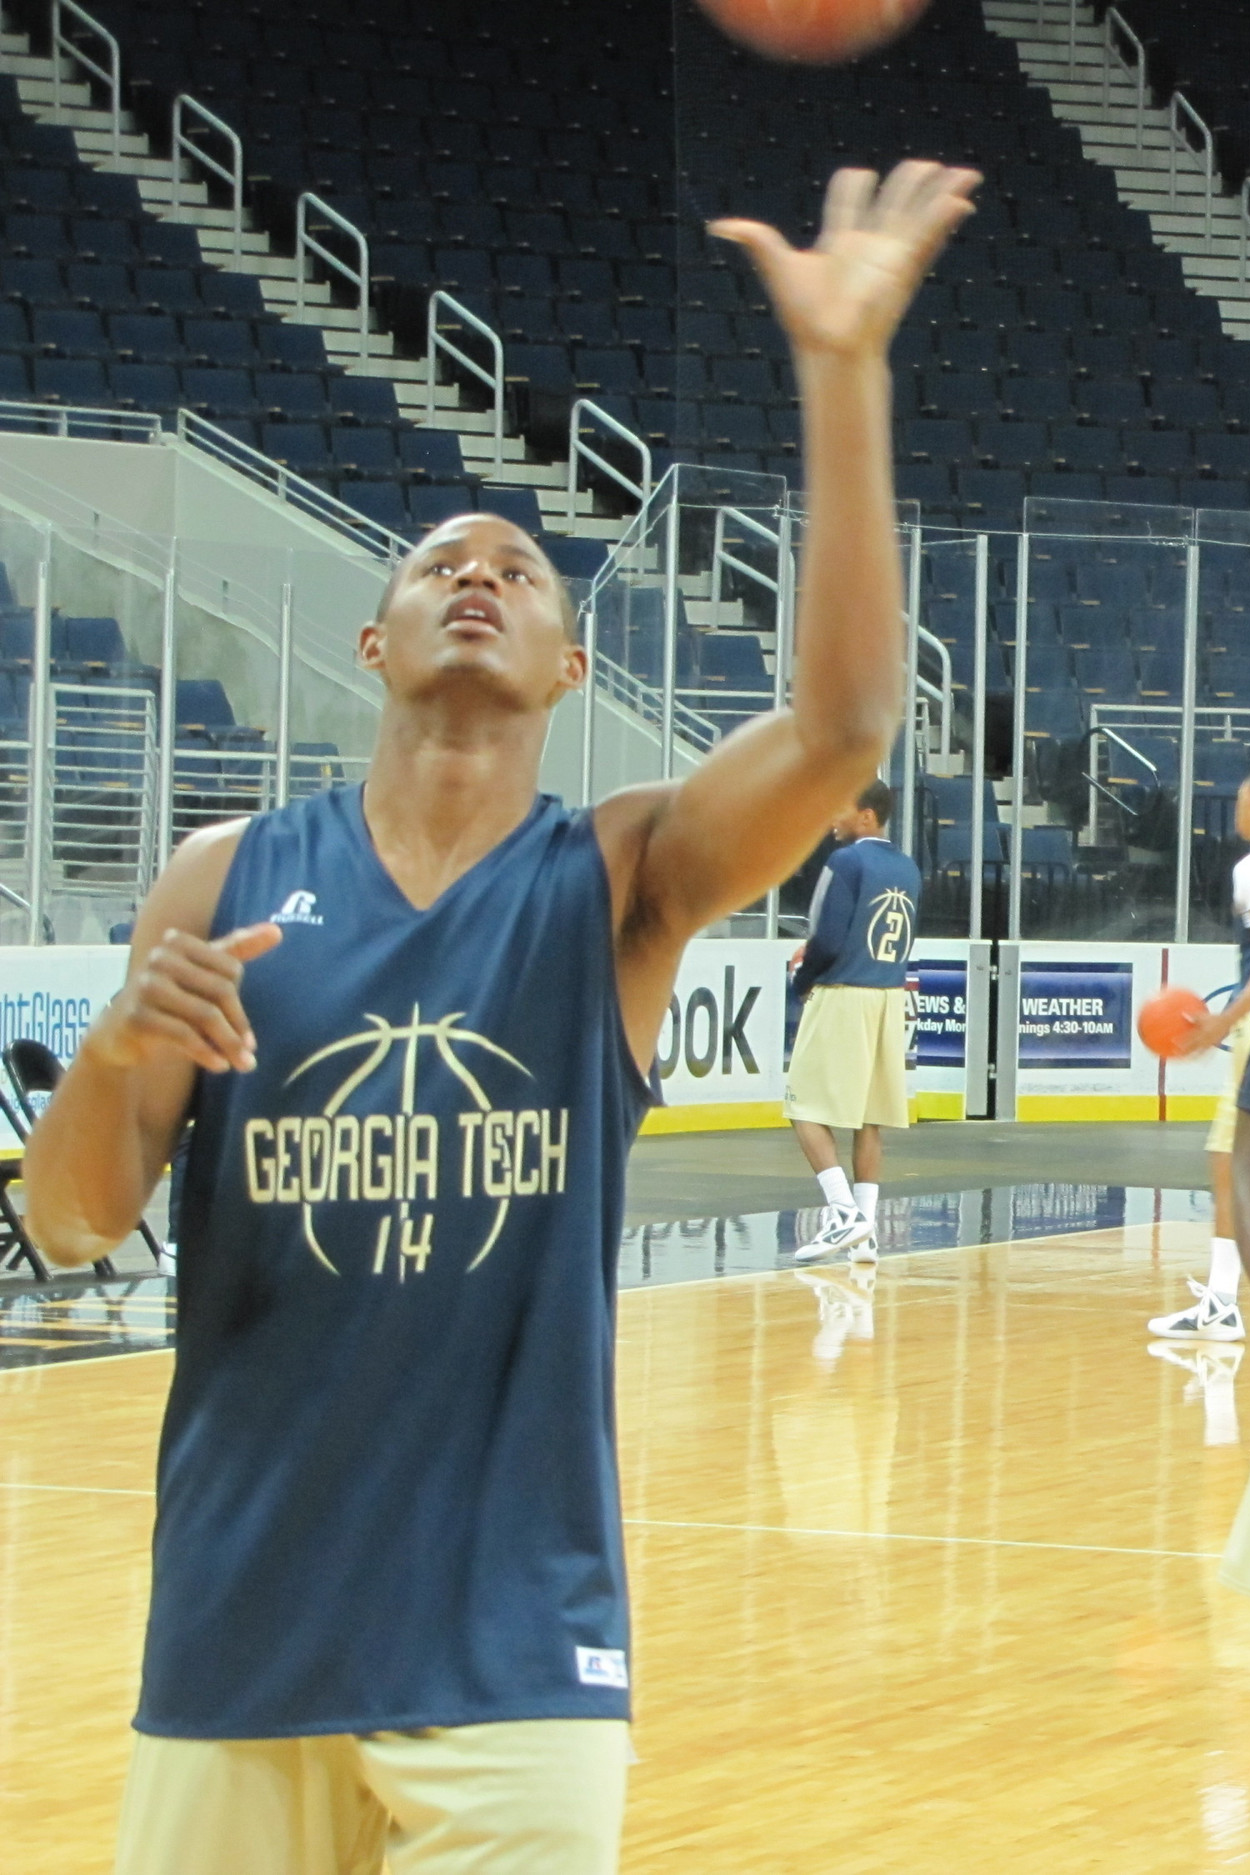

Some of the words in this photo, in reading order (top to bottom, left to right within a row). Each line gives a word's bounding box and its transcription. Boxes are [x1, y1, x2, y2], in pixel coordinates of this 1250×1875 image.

[877, 911, 904, 962] 2
[953, 996, 967, 1014] &
[1022, 998, 1103, 1016] WEATHER
[1052, 1020, 1114, 1035] 4:30-10AM
[244, 1113, 439, 1203] GEORGIA
[458, 1107, 568, 1198] TECH
[372, 1213, 434, 1275] 14
